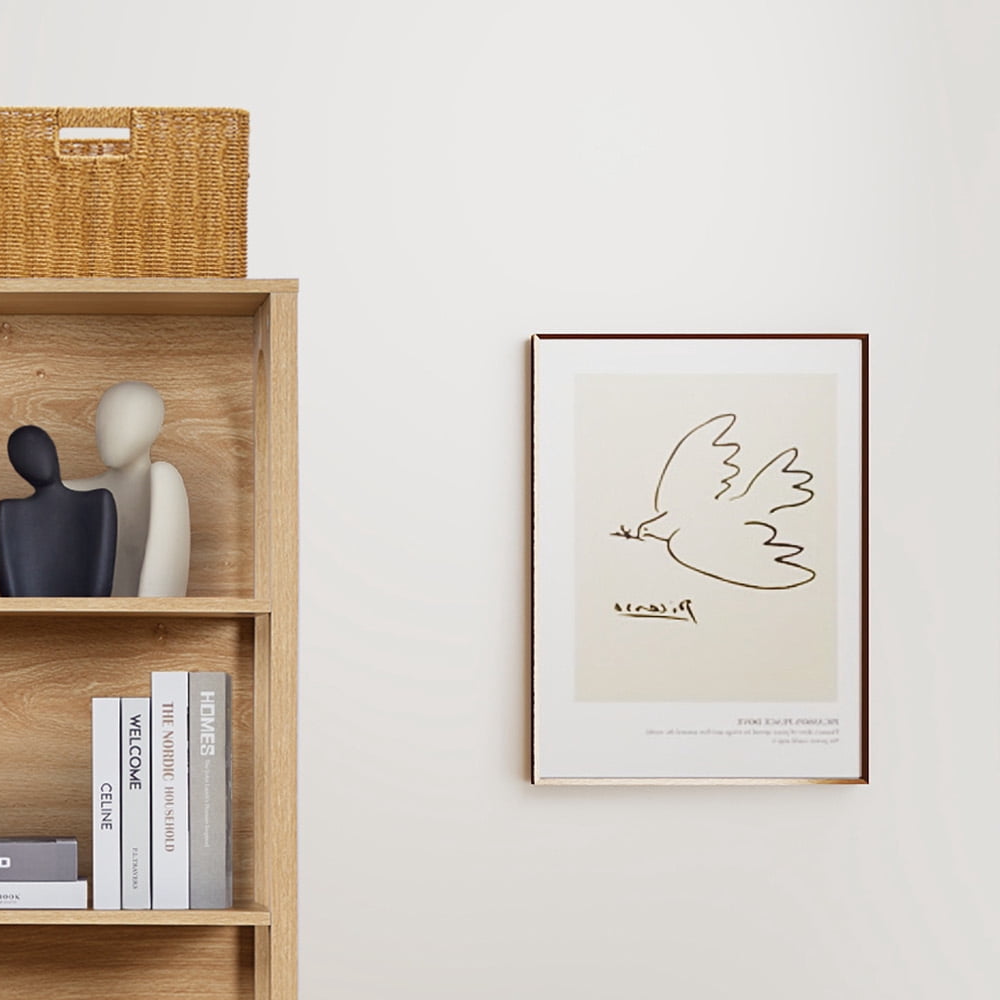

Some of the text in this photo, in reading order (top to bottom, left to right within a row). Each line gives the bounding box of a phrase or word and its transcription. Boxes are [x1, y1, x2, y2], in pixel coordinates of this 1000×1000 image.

[129, 714, 142, 790] WELCOME
[200, 691, 216, 756] HOMES
[100, 782, 113, 830] CELINE
[162, 702, 175, 853] THE NORDIC HOUSEHOLD
